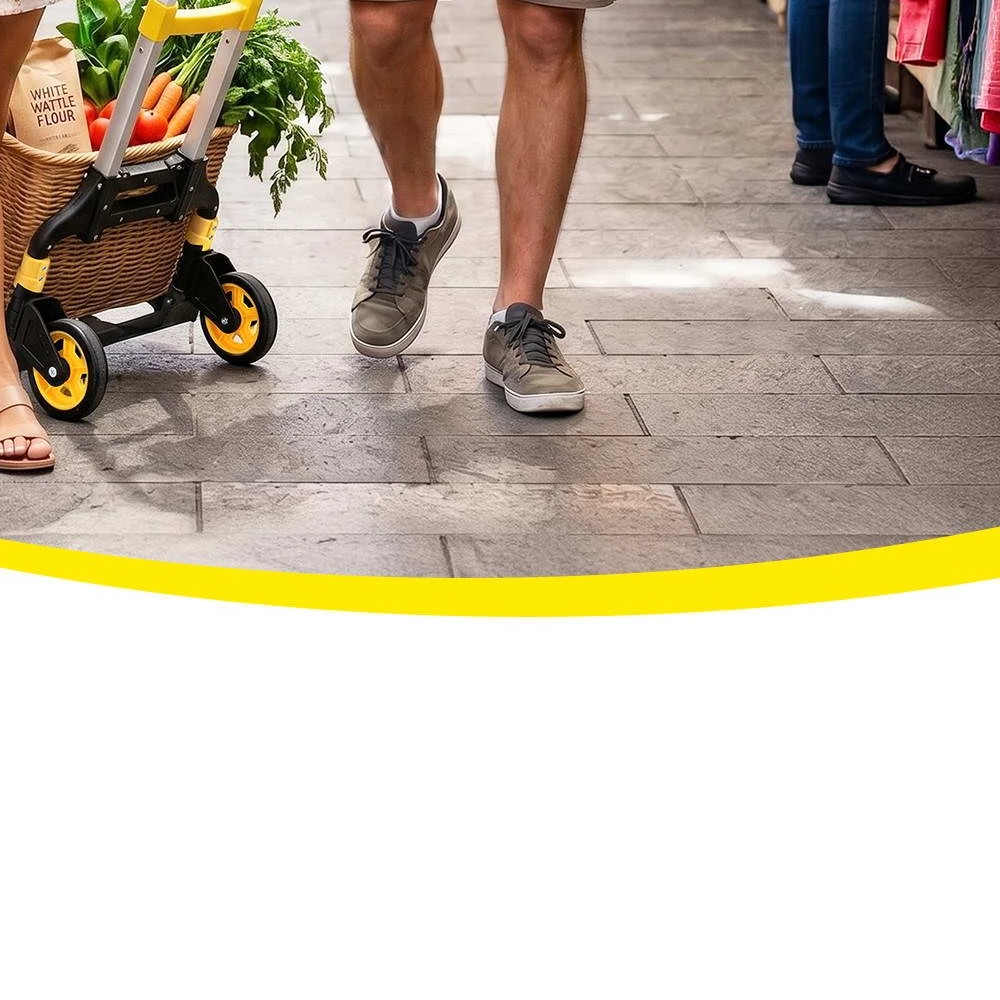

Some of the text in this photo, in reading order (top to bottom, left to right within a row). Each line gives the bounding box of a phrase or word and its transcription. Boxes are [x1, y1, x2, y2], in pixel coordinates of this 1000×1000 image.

[30, 83, 69, 101] WHITE
[30, 95, 77, 114] WATTLE
[36, 109, 76, 127] FLOUR
